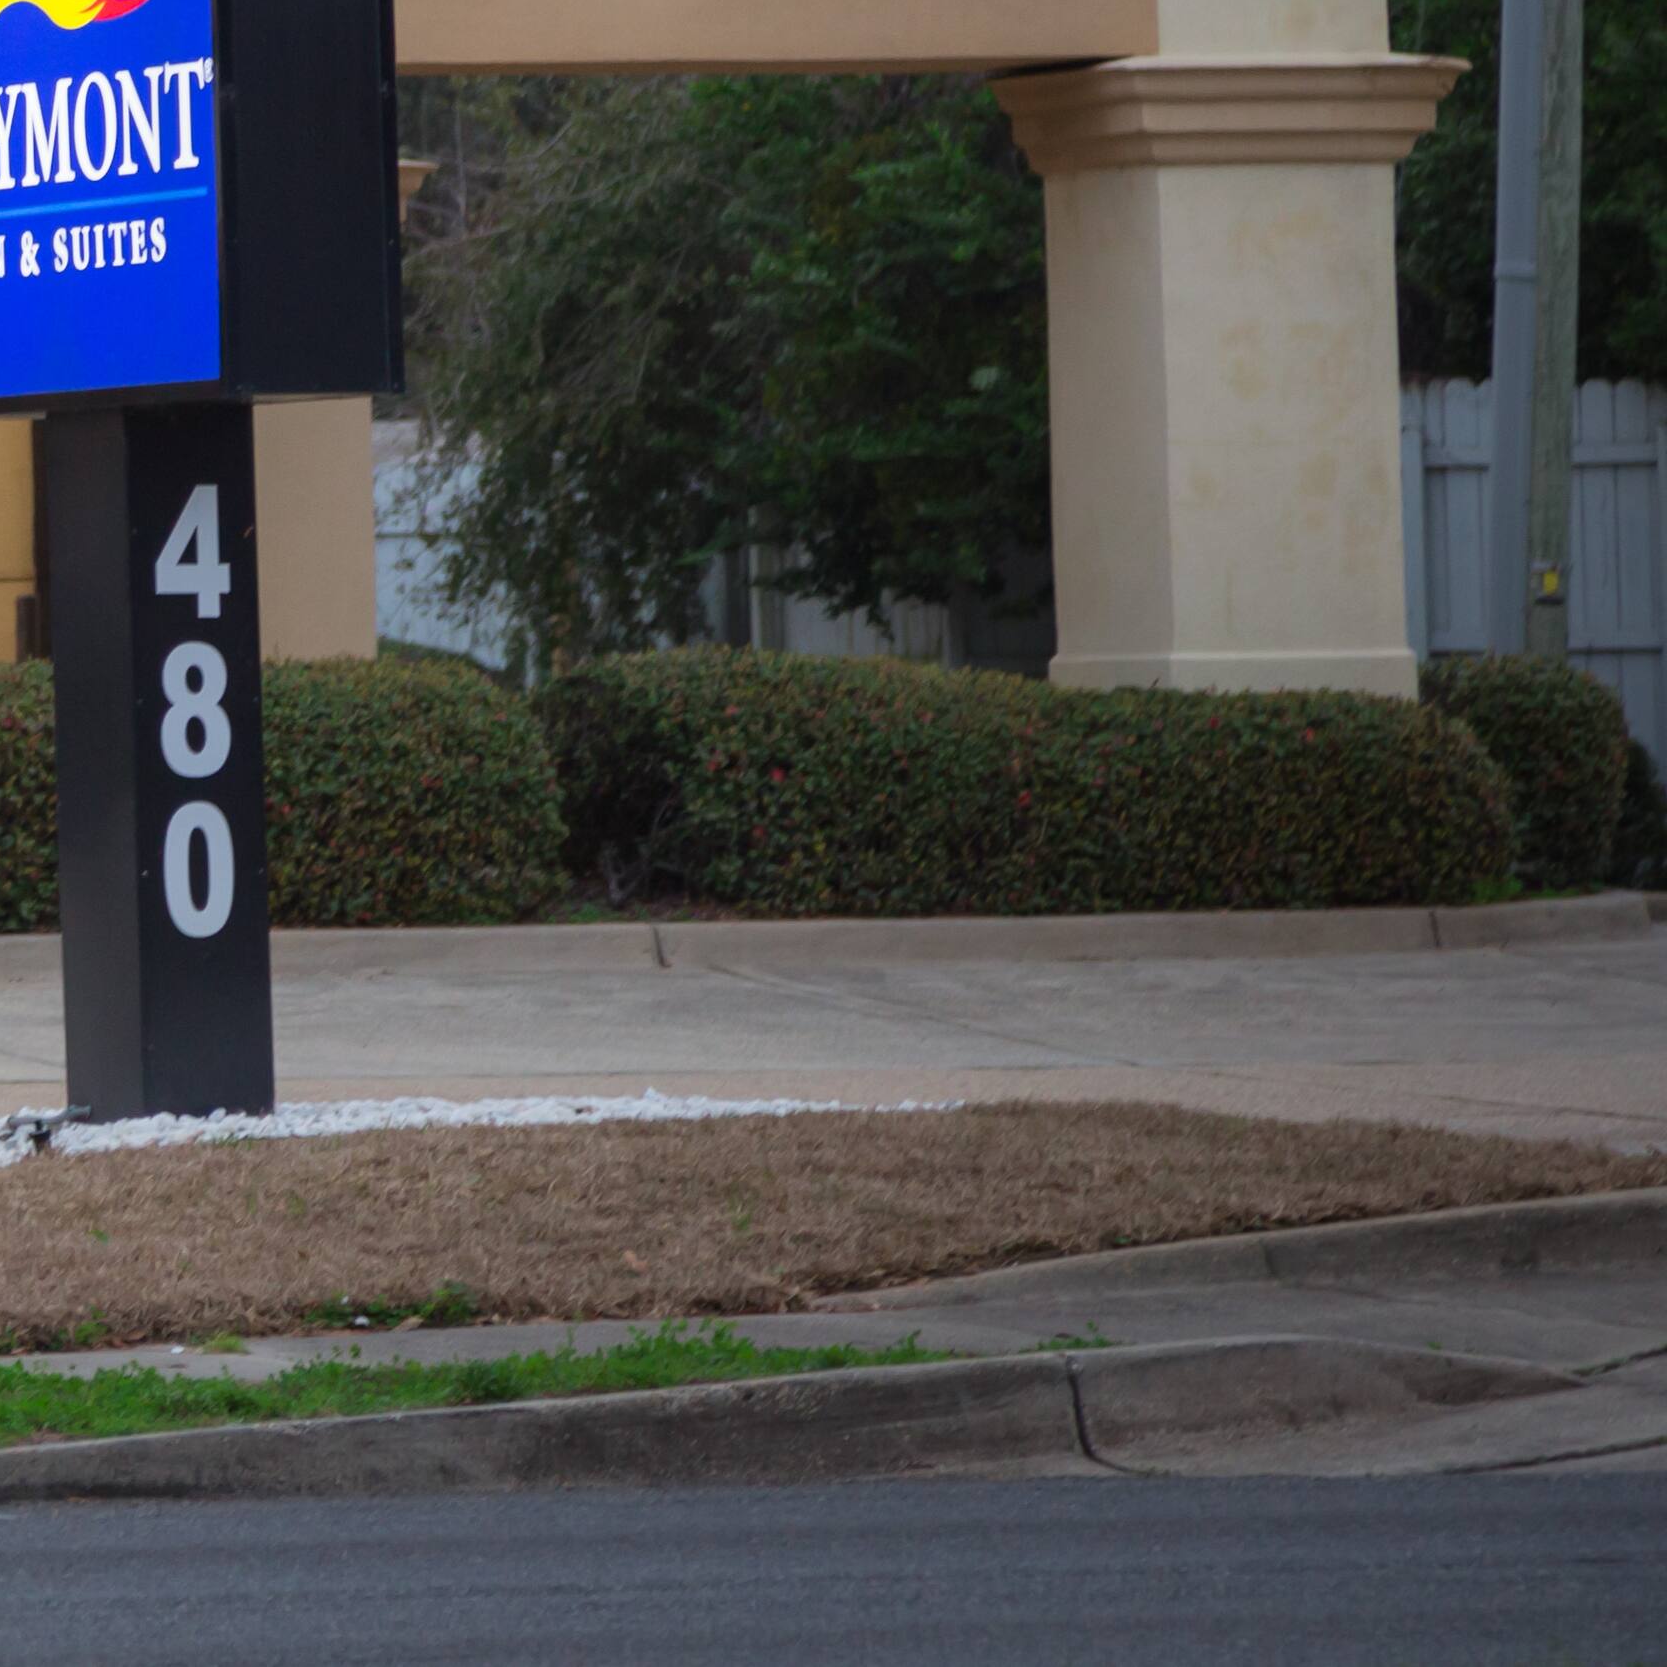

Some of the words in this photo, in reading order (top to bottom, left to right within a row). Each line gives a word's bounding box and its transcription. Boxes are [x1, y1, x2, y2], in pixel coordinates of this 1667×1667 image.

[20, 231, 40, 277] &
[53, 217, 167, 272] SUITES
[154, 483, 235, 938] 480
